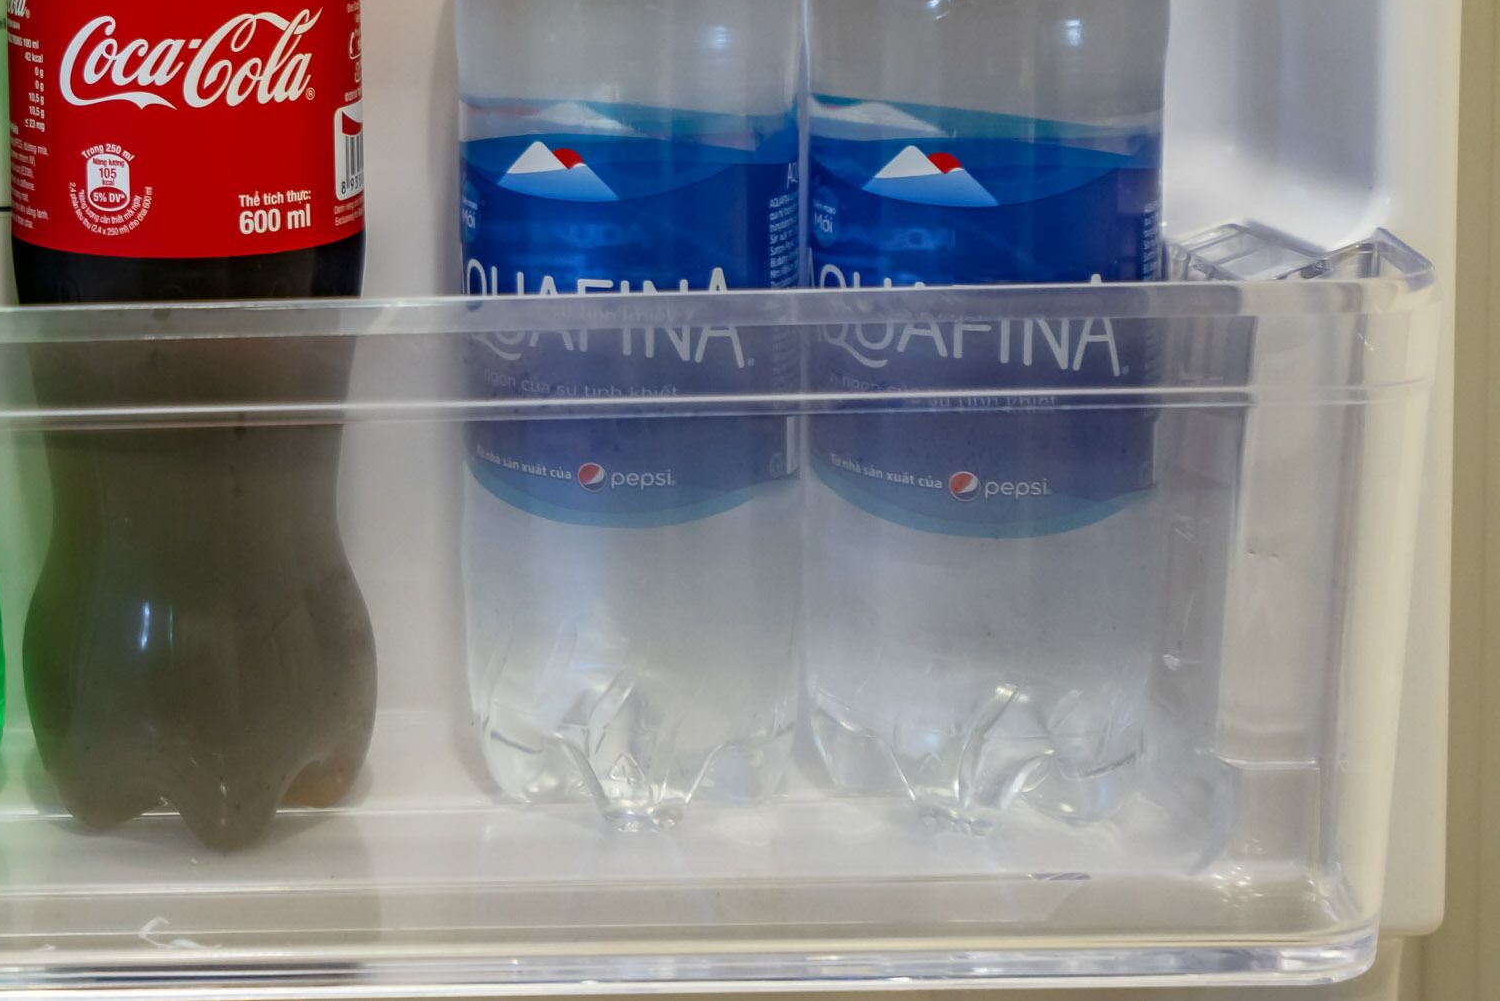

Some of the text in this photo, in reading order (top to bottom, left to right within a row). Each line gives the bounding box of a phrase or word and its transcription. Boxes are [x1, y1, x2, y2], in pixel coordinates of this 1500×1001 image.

[59, 7, 323, 110] Coca-Cola
[81, 143, 135, 161] Trong 250 ml
[99, 168, 117, 179] 105
[93, 192, 107, 202] 5%
[238, 189, 311, 207] Thể tích thực:
[341, 181, 347, 194] 8
[239, 203, 311, 235] 600 ml
[503, 456, 520, 470] sản
[522, 460, 547, 476] xuất
[550, 466, 572, 480] của
[863, 463, 883, 479] sản
[886, 470, 915, 485] xuất
[918, 474, 942, 489] của
[611, 469, 672, 490] pepsi
[984, 478, 1048, 499] pepsi
